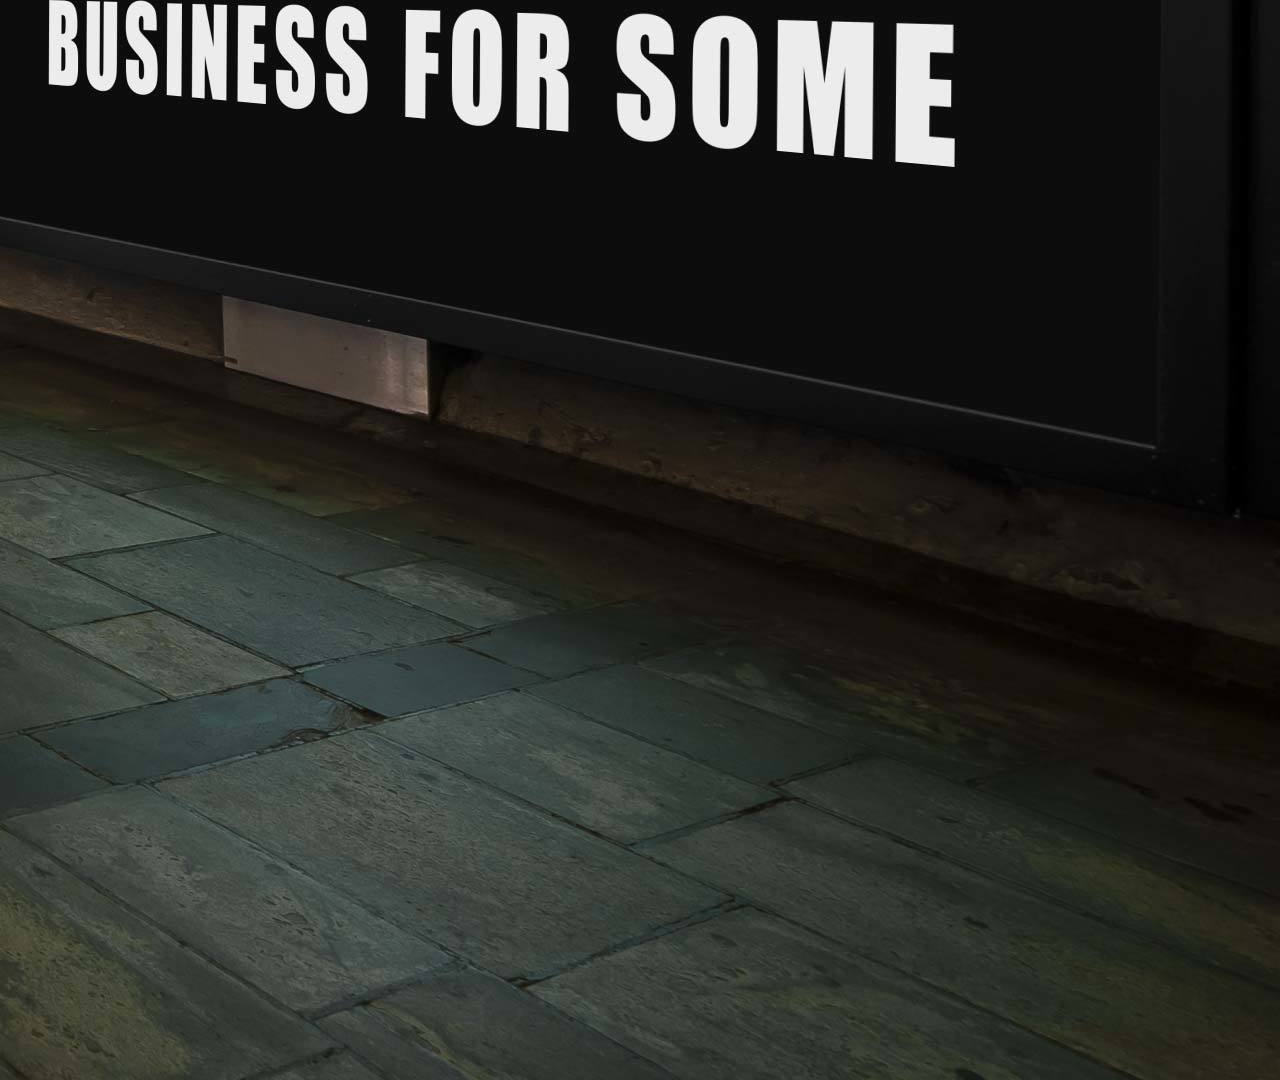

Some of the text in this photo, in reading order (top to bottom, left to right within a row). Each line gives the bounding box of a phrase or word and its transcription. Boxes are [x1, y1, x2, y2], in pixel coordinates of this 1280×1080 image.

[49, 0, 955, 167] BUSINESS FOR SOME
